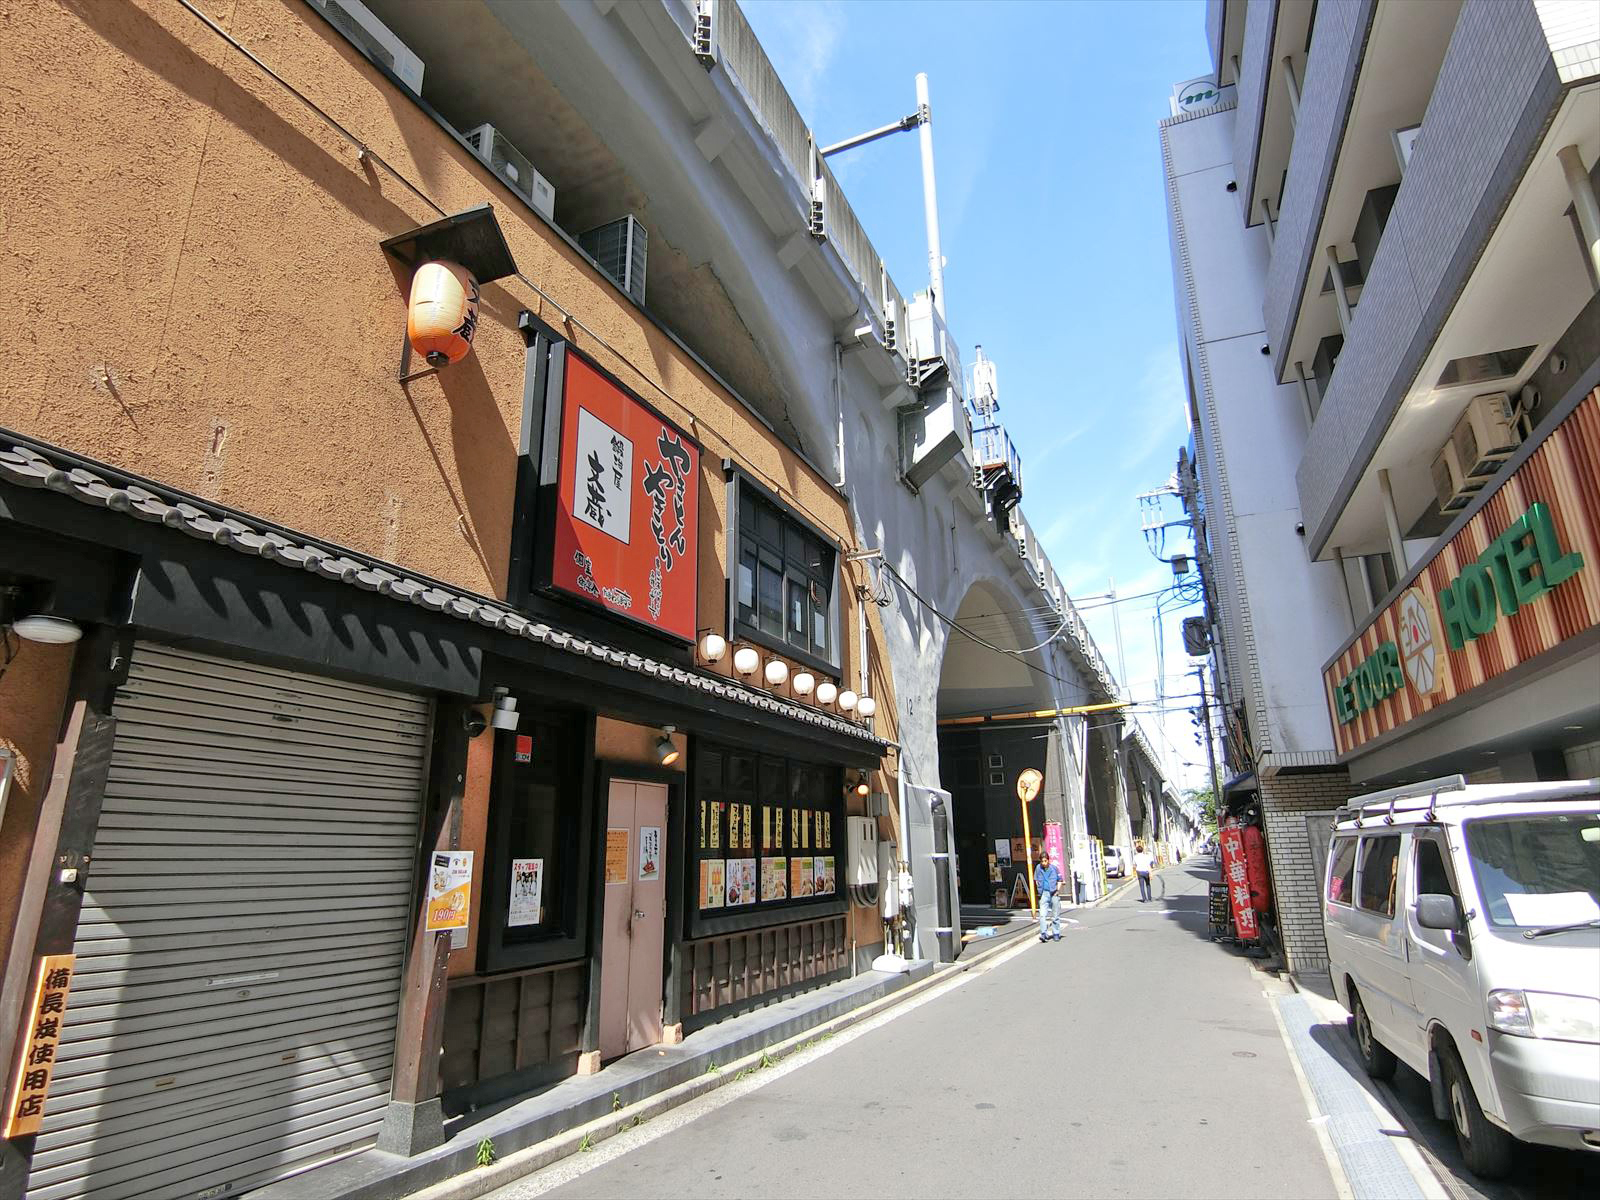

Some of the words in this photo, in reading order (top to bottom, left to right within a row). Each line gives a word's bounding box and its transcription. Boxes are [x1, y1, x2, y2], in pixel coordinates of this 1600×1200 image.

[642, 459, 675, 572] やきとり
[657, 426, 692, 556] やきとん
[1439, 502, 1585, 652] HOTEL
[1224, 836, 1257, 929] 中華料理
[17, 968, 70, 1118] 備長炭使用店
